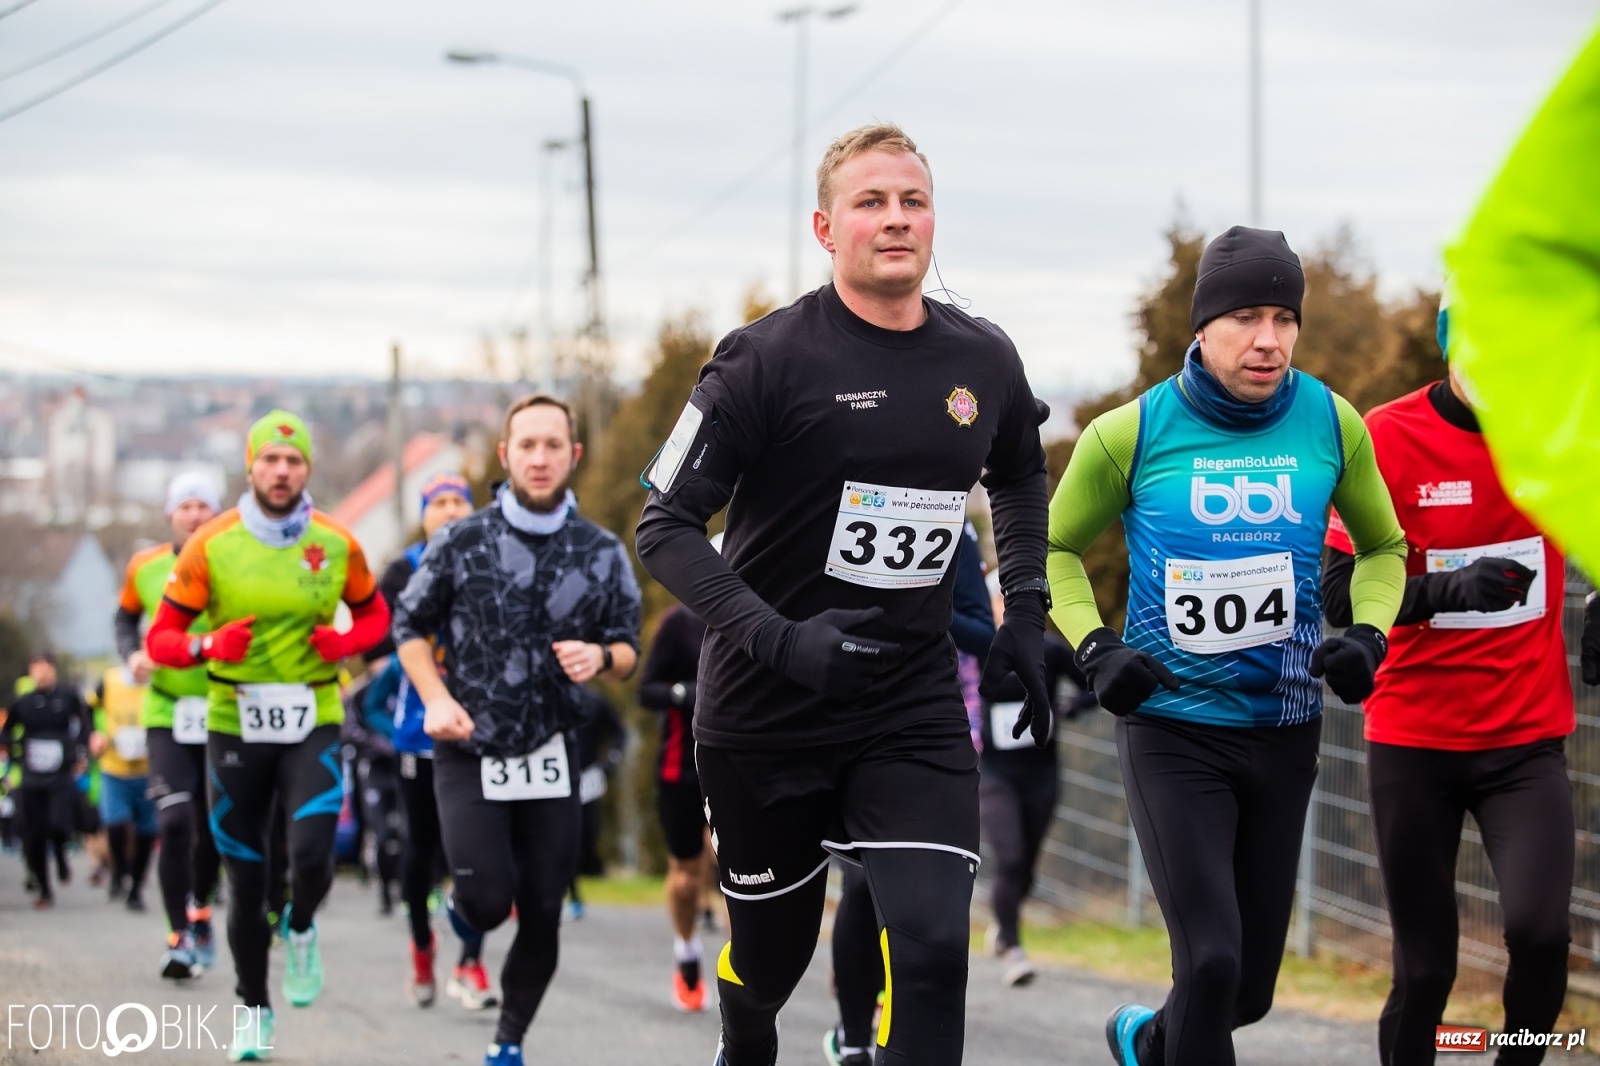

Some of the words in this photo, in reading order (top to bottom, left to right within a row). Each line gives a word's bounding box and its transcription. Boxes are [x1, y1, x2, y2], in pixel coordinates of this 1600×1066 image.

[836, 390, 888, 402] RUSNARCZYK
[850, 400, 879, 410] PAWEŁ
[891, 499, 962, 513] www.personalbest.pl
[1190, 474, 1302, 525] bbl
[1212, 530, 1282, 542] RACIBÓRZ
[840, 521, 953, 570] 332
[1209, 563, 1289, 579] www.personalbest.pl
[1174, 587, 1288, 636] 304
[247, 706, 309, 730] 387
[490, 757, 561, 785] 315
[728, 868, 775, 886] hummel
